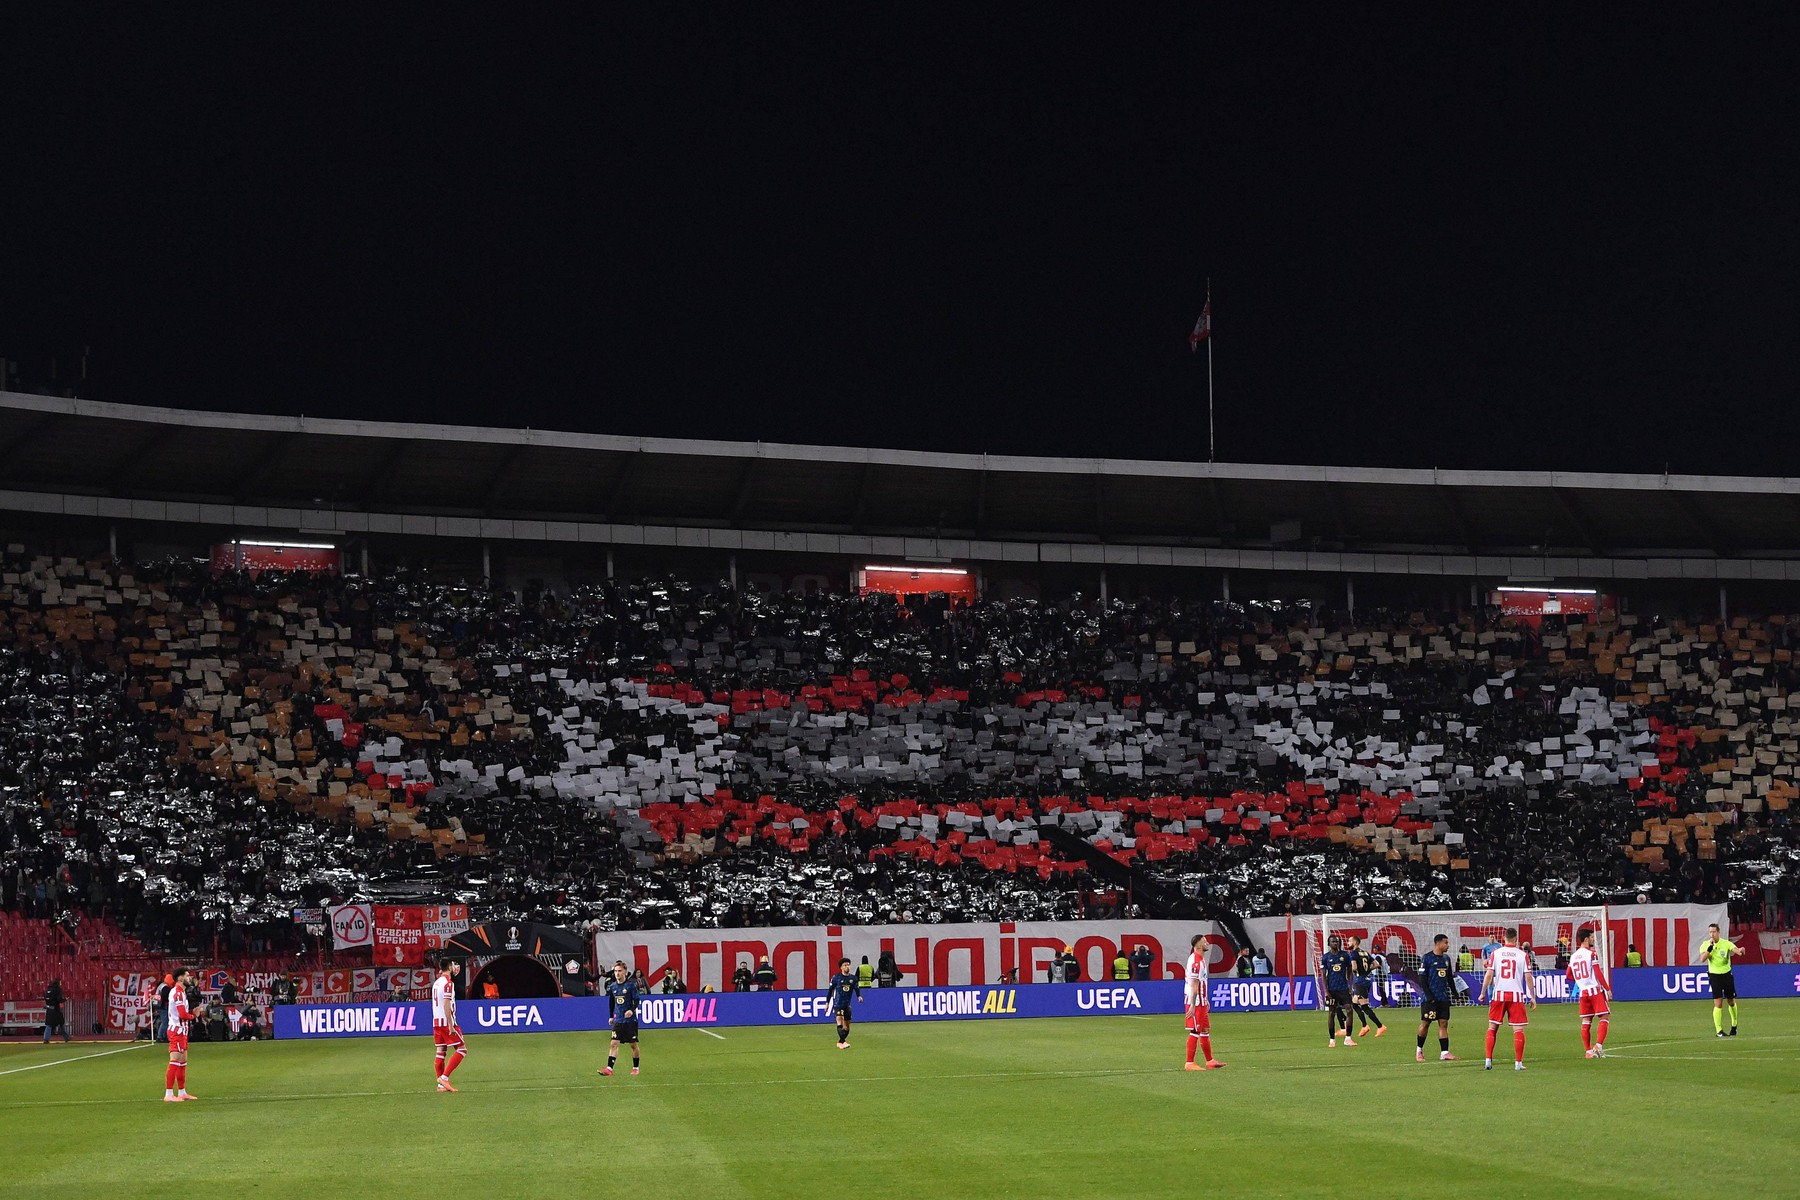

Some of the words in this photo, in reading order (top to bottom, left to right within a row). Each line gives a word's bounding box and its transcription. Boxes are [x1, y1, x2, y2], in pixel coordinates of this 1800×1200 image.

[336, 921, 352, 931] FAN
[355, 919, 365, 930] ID
[376, 927, 422, 937] СЕВЕРНА
[378, 936, 418, 944] СРБИЈА
[1362, 957, 1368, 972] 6
[1501, 959, 1516, 979] 21
[1573, 960, 1589, 980] 20
[1663, 972, 1712, 994] UEF
[434, 988, 438, 1007] 4
[902, 990, 981, 1016] WELCOME
[982, 989, 1017, 1014] ALL
[1076, 987, 1142, 1010] UEFA
[1212, 981, 1313, 1008] #FOOTBALL
[300, 1007, 380, 1034] WELCOME
[381, 1006, 416, 1031] ALL
[478, 1005, 543, 1027] UEFA
